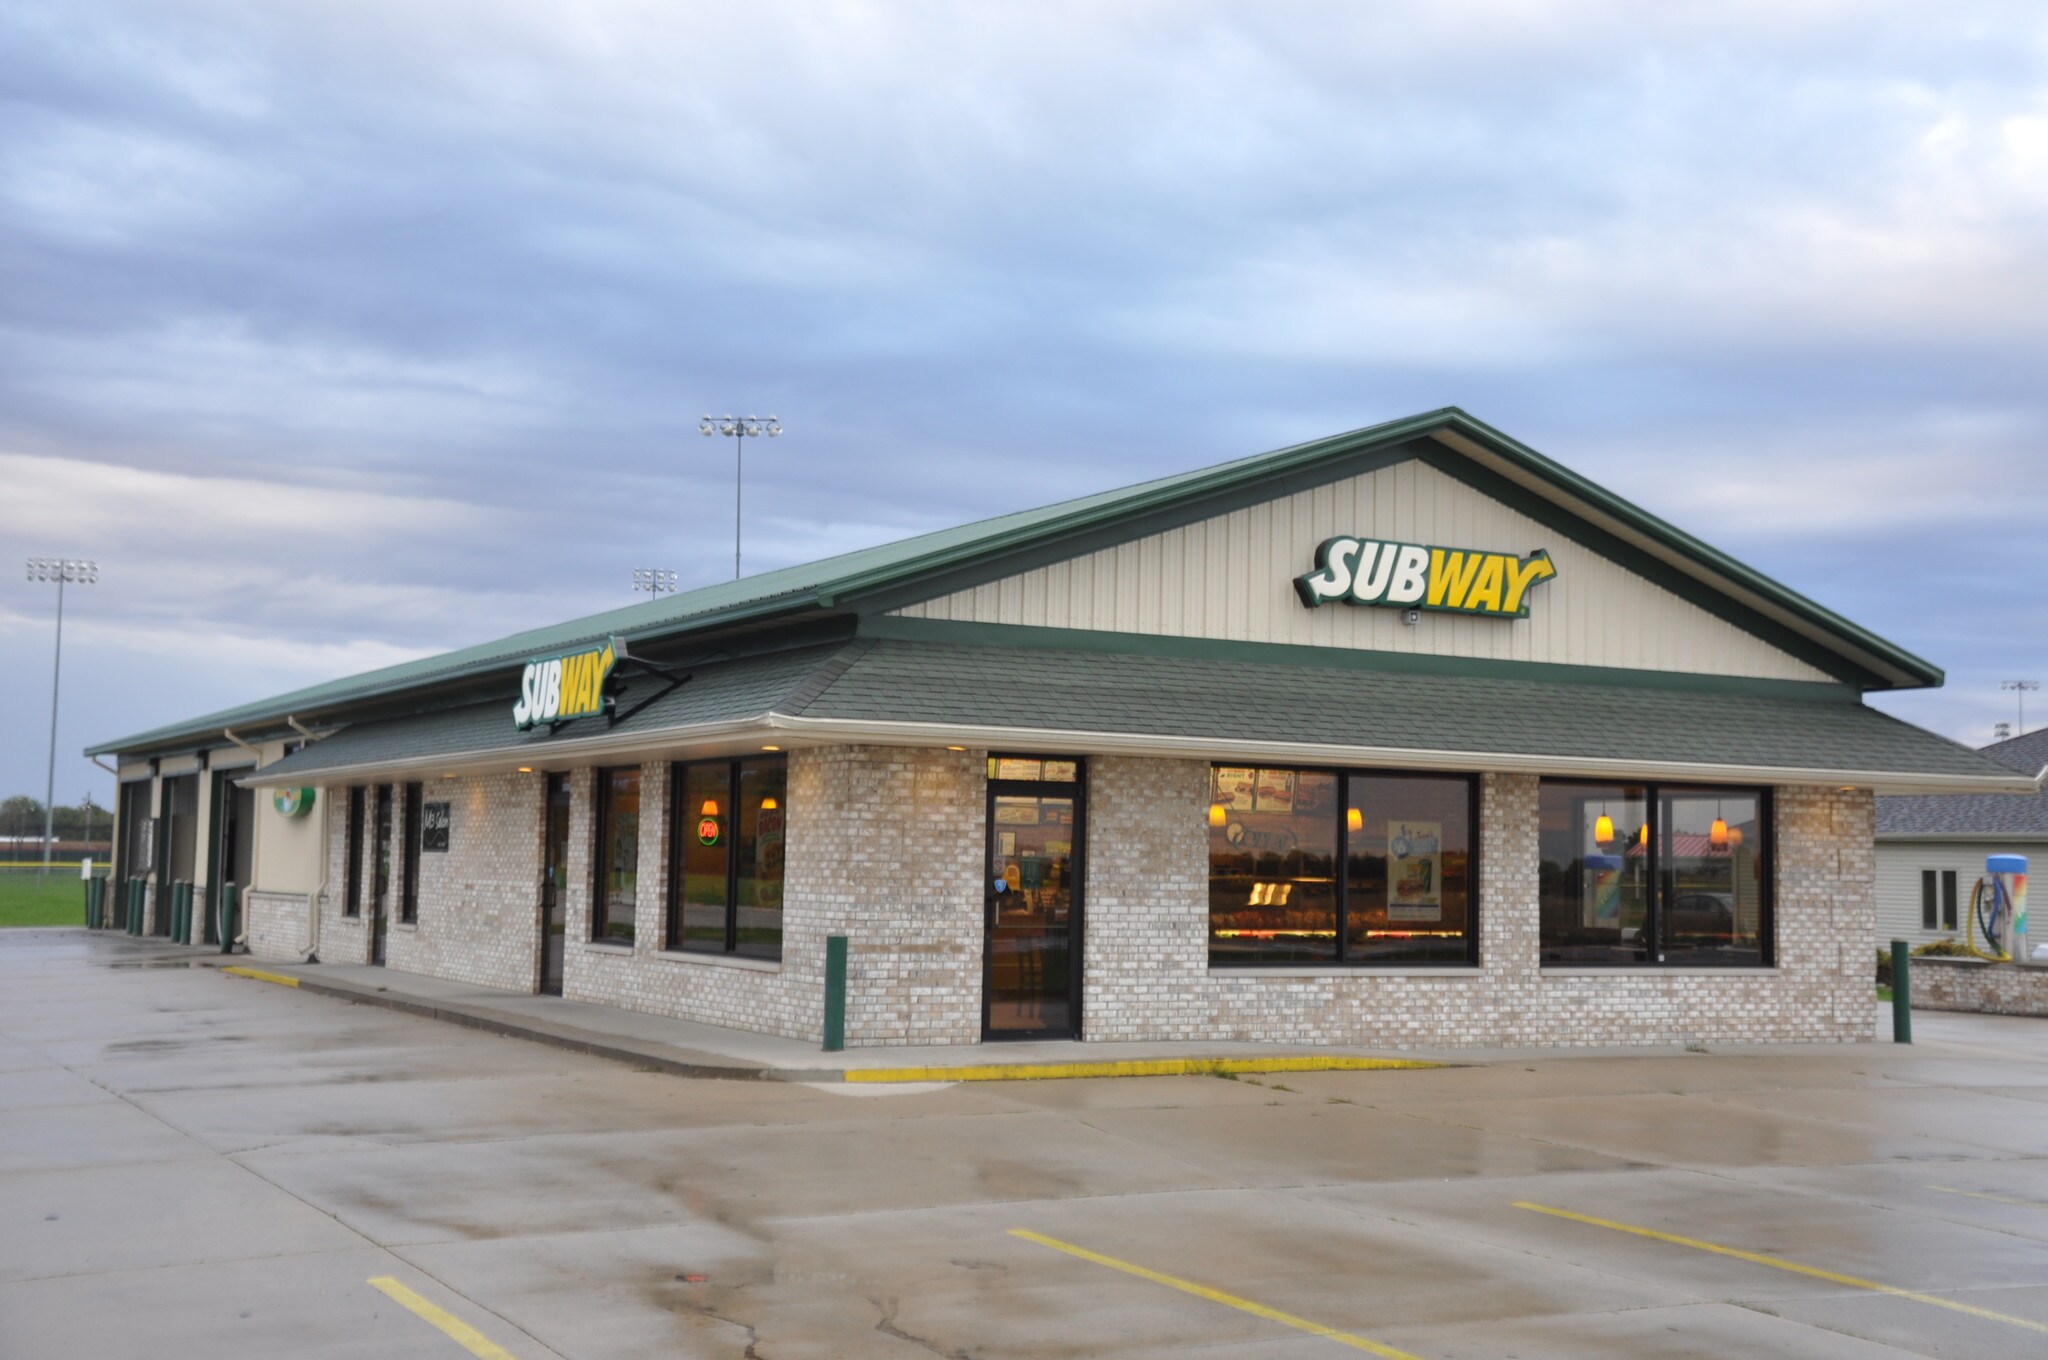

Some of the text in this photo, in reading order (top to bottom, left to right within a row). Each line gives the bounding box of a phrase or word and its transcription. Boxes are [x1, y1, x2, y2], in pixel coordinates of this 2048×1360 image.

[1309, 539, 1556, 612] SUBWAY
[512, 641, 615, 727] SUBWAY
[700, 820, 717, 838] OPEN
